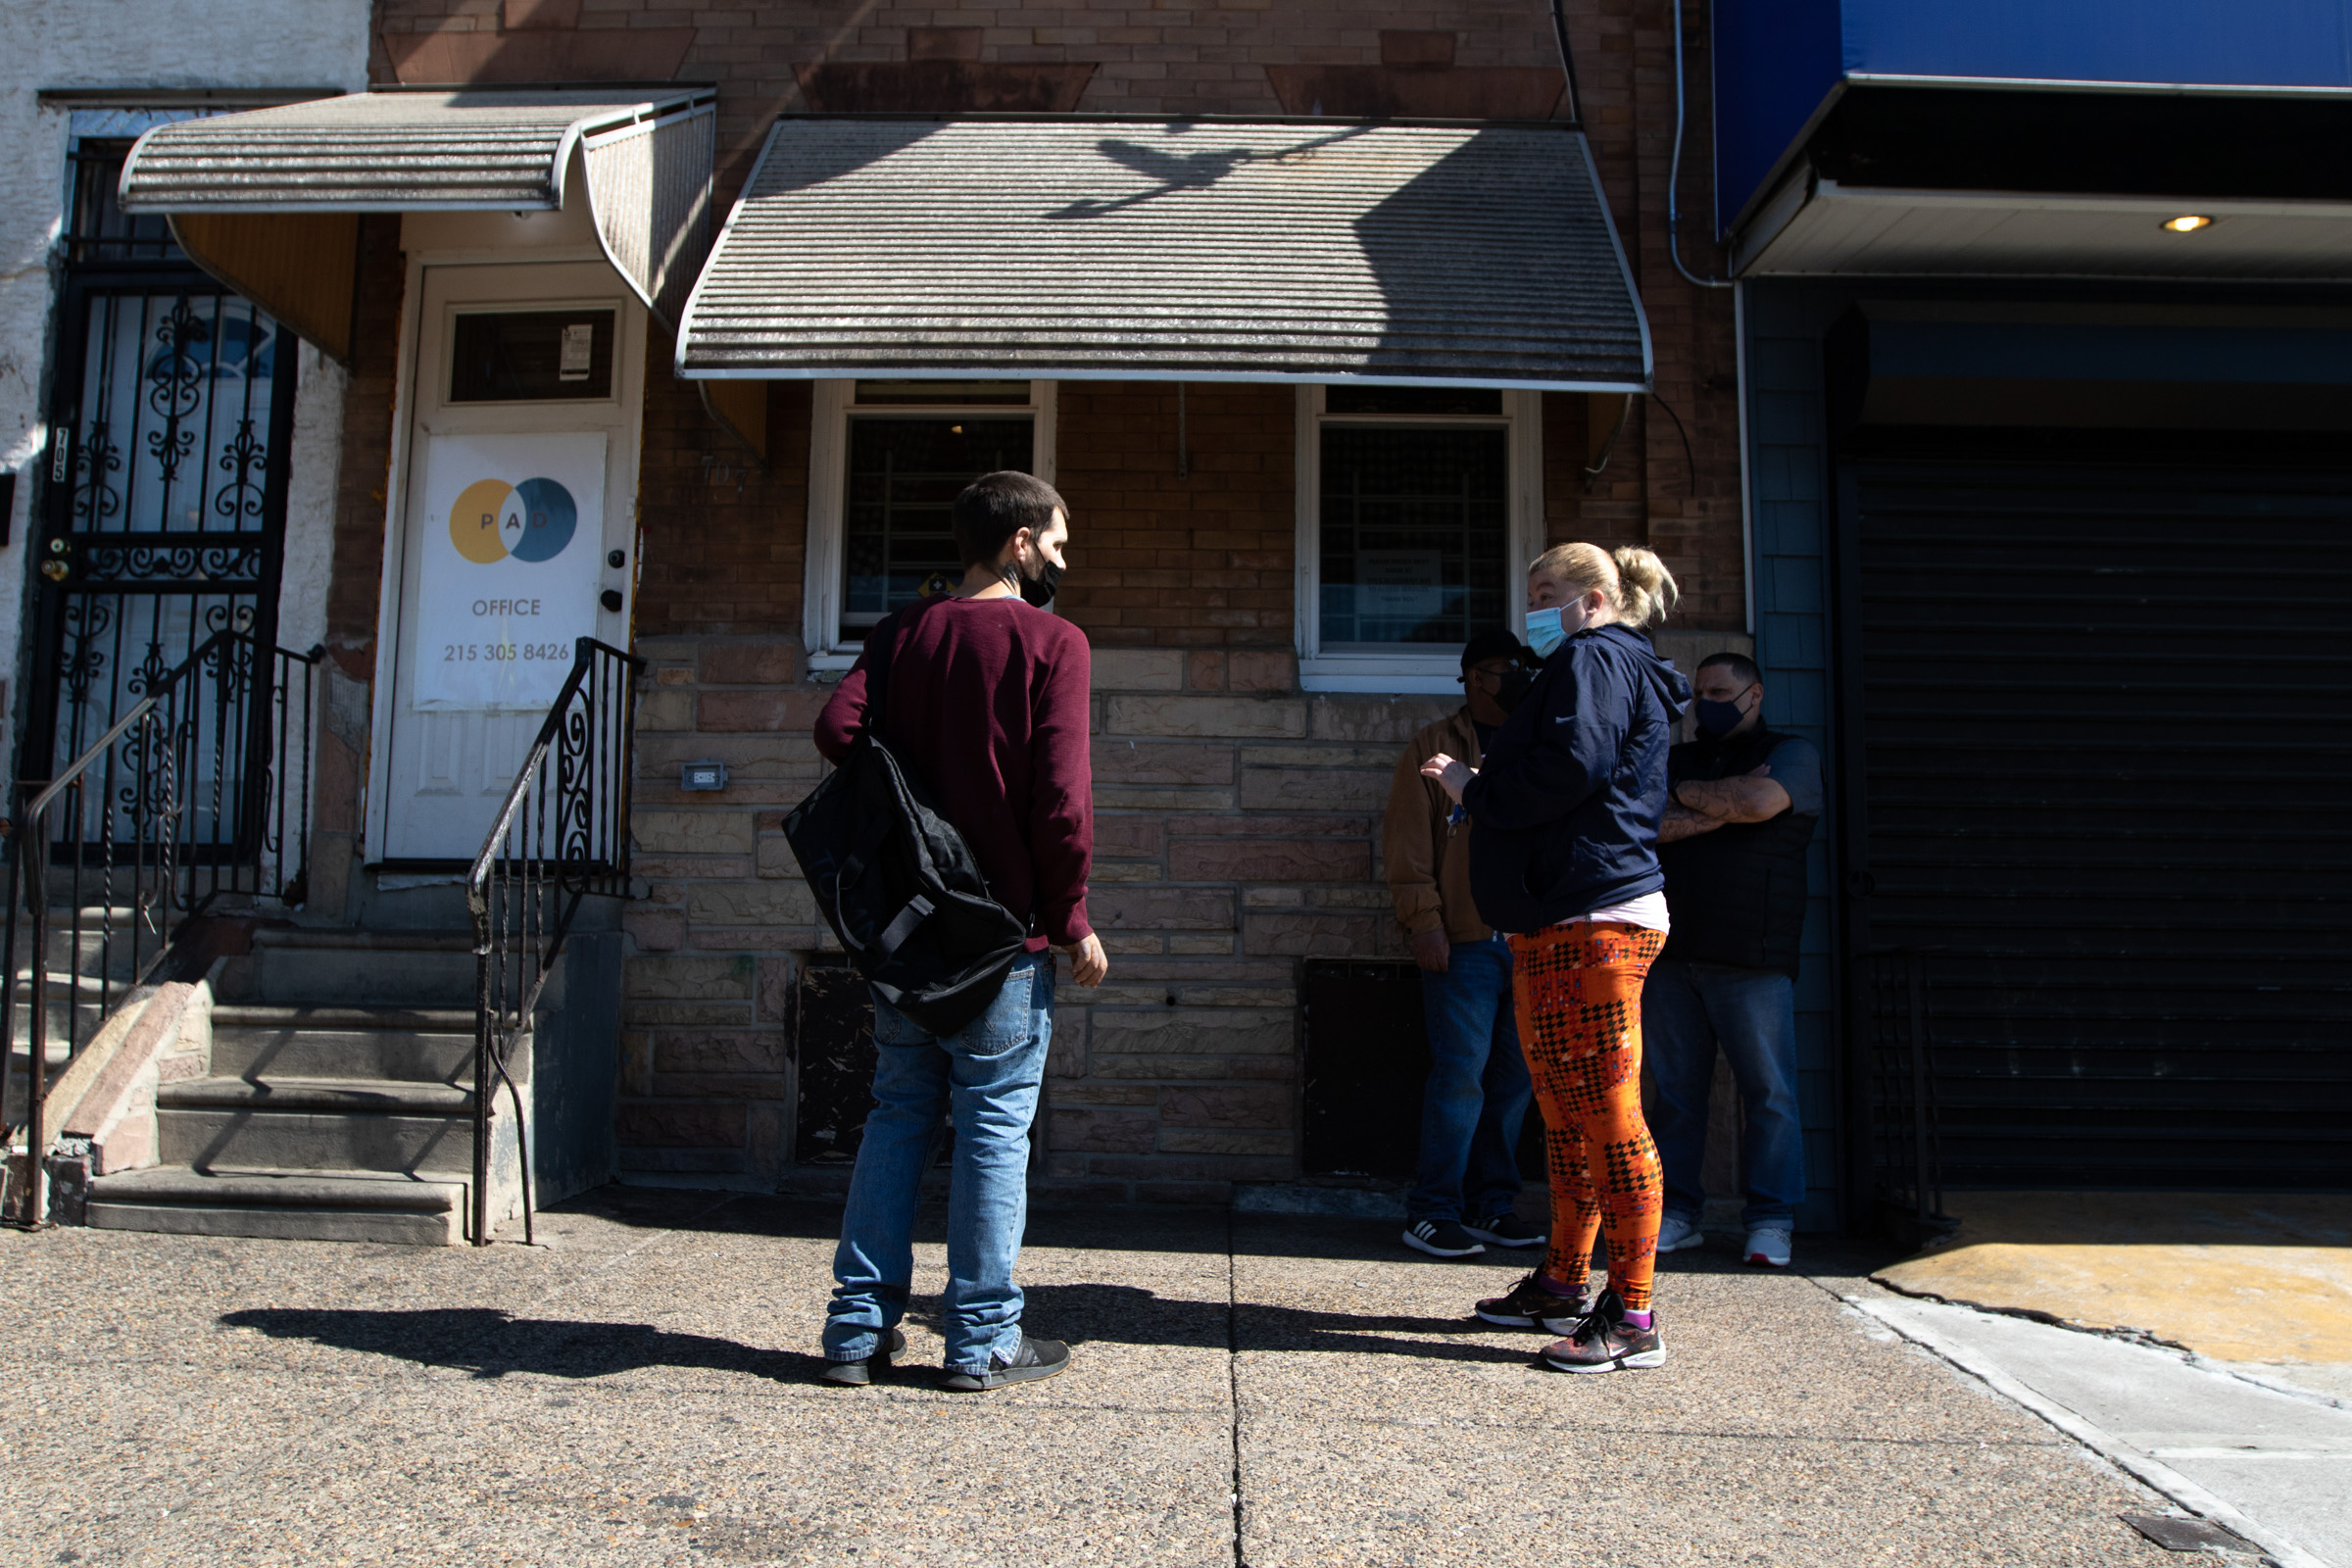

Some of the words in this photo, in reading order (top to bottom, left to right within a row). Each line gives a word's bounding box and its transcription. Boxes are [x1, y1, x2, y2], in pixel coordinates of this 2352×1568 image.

[54, 428, 67, 480] 705
[480, 513, 548, 530] PAD
[472, 599, 541, 616] OFFICE
[444, 644, 477, 662] 215
[483, 643, 517, 661] 305
[523, 643, 569, 661] 8426
